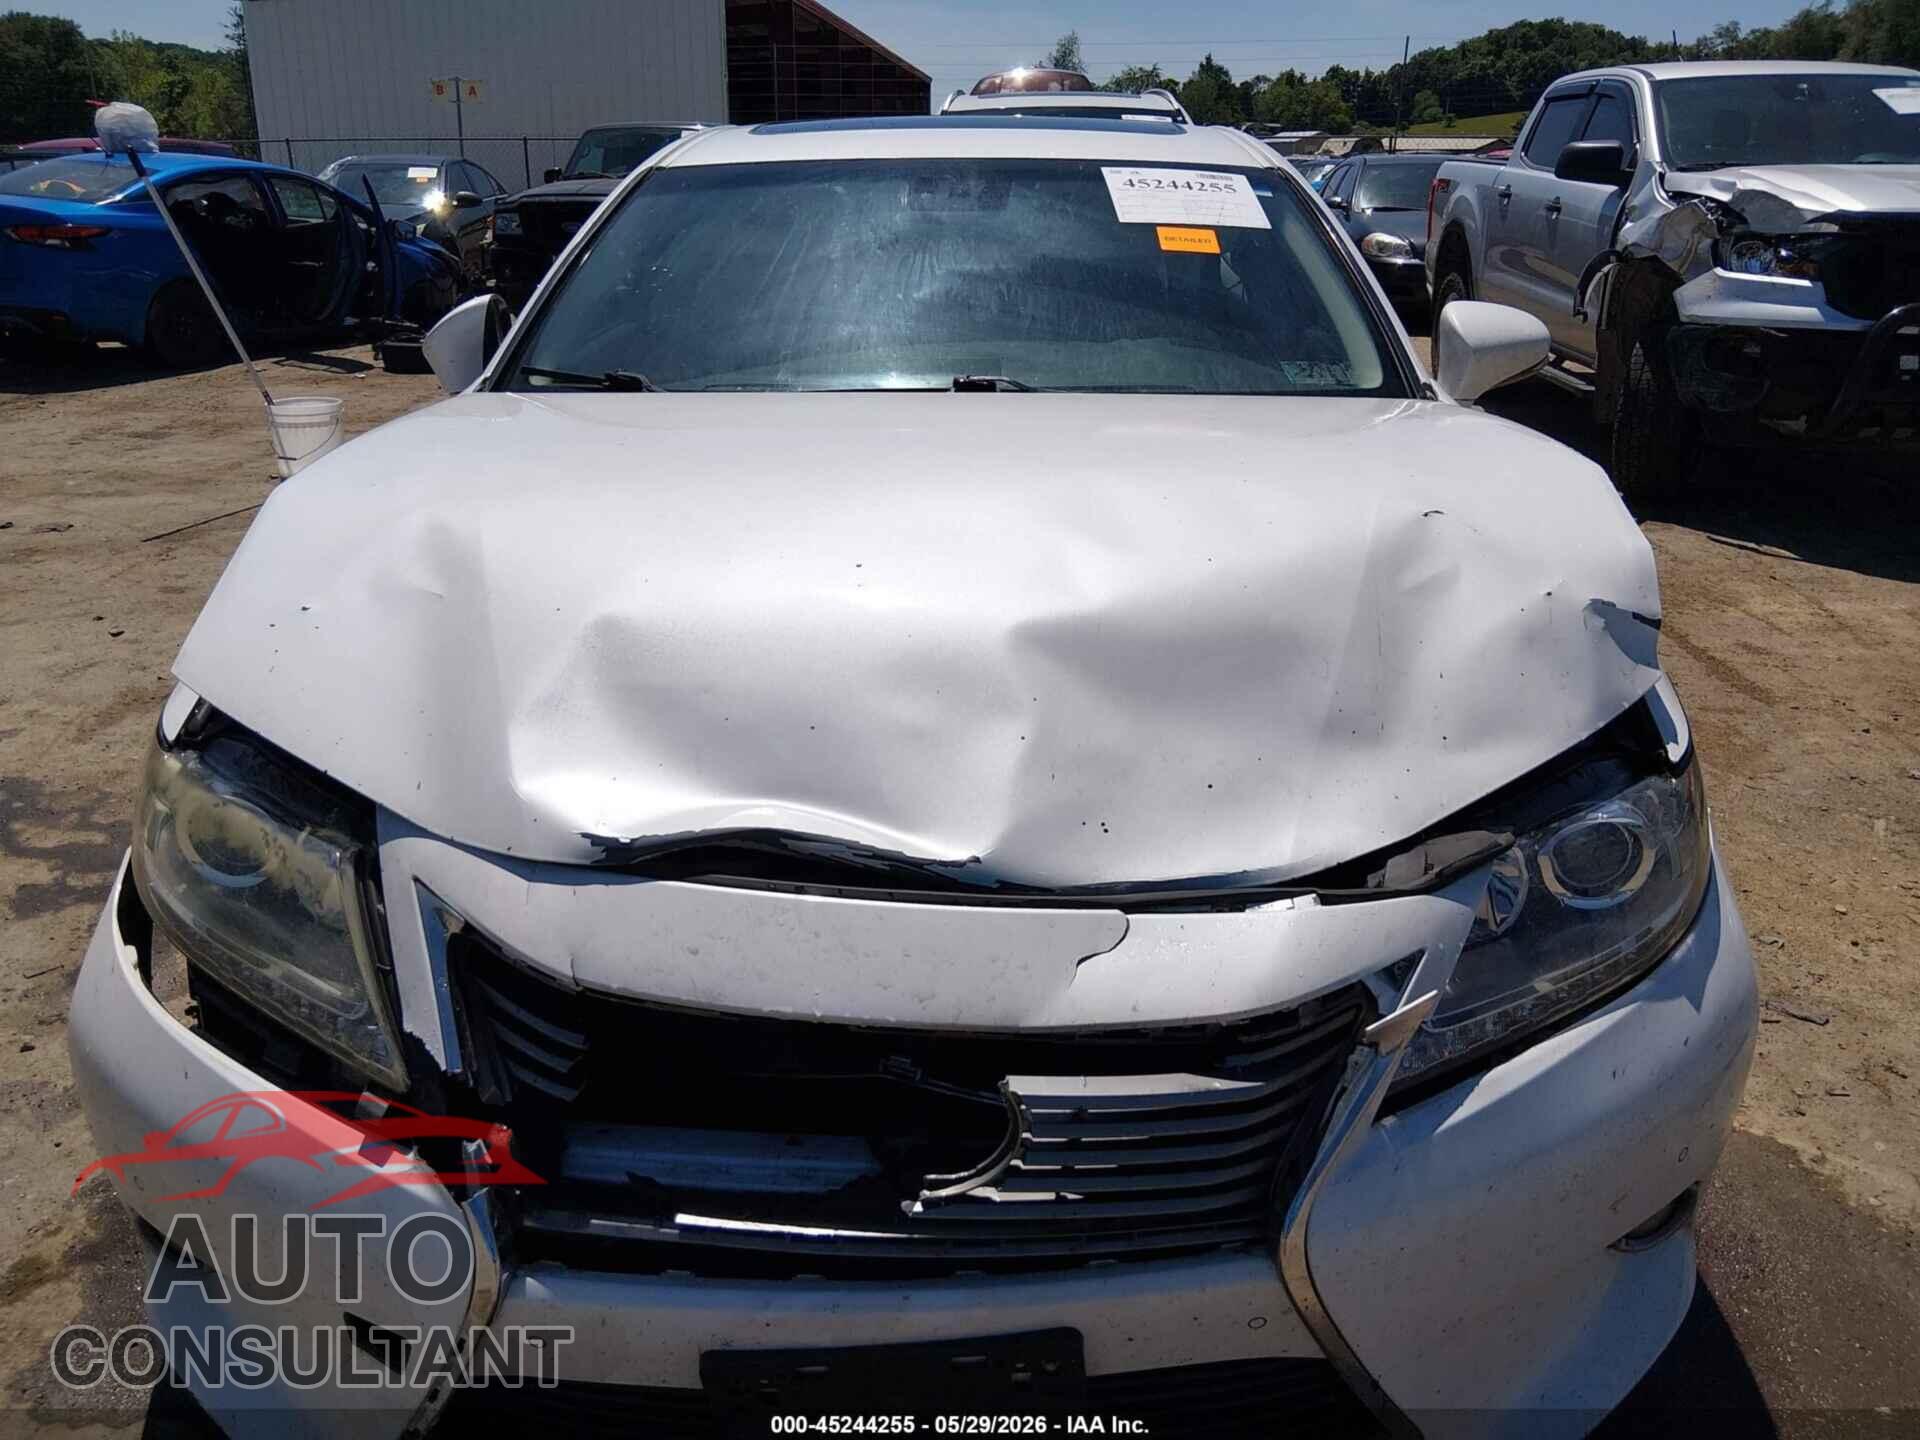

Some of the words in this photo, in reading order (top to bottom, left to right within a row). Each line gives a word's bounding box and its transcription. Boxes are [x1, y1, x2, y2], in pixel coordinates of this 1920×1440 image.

[435, 84, 445, 96] B
[468, 85, 478, 97] A
[1122, 177, 1238, 194] 45244255
